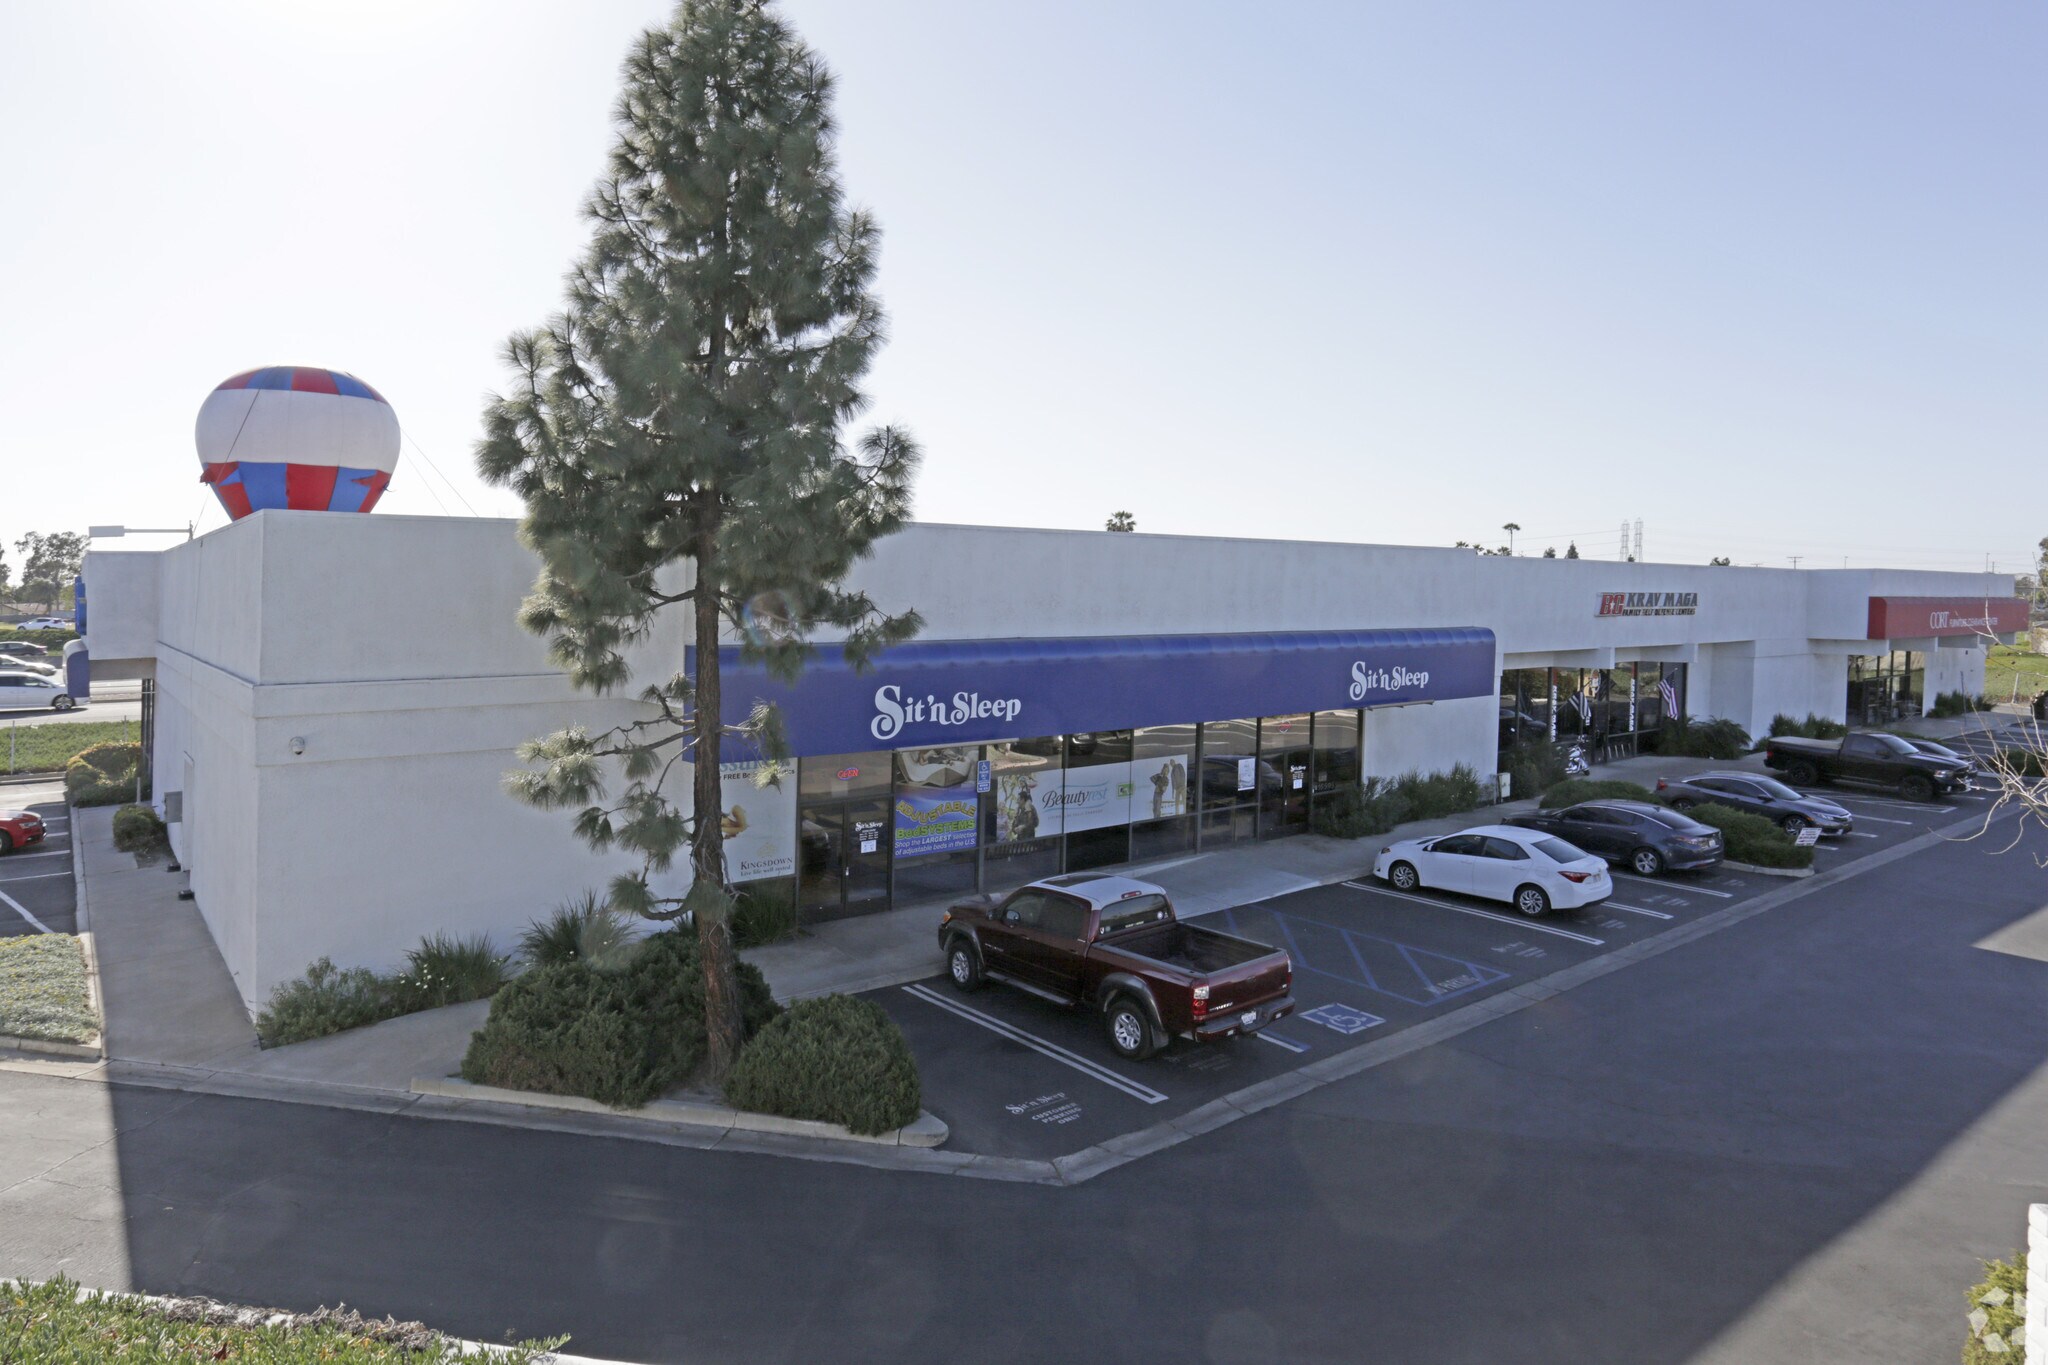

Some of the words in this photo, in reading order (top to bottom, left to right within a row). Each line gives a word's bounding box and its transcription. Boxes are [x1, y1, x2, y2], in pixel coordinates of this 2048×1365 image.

[1600, 592, 1626, 616] BC
[1626, 592, 1661, 607] KRAV
[1662, 592, 1698, 607] MAGA
[1929, 611, 1950, 630] CORT
[1349, 661, 1391, 701] Sit'n
[1391, 666, 1429, 690] Sleep
[870, 684, 951, 740] Sit'n
[950, 691, 1022, 725] Sleep
[723, 772, 741, 781] FREE
[1041, 787, 1108, 809] Beautyrest
[895, 799, 977, 824] ADJUSTABLE
[894, 841, 911, 850] Shop
[922, 835, 951, 845] LARGEST
[953, 831, 977, 840] selection
[894, 847, 902, 856] of
[902, 844, 933, 855] adjustable
[932, 841, 948, 851] beds
[1031, 1102, 1078, 1121] CUSTOMER
[1041, 1107, 1082, 1124] PARKING
[1057, 1113, 1081, 1125] ONLY
